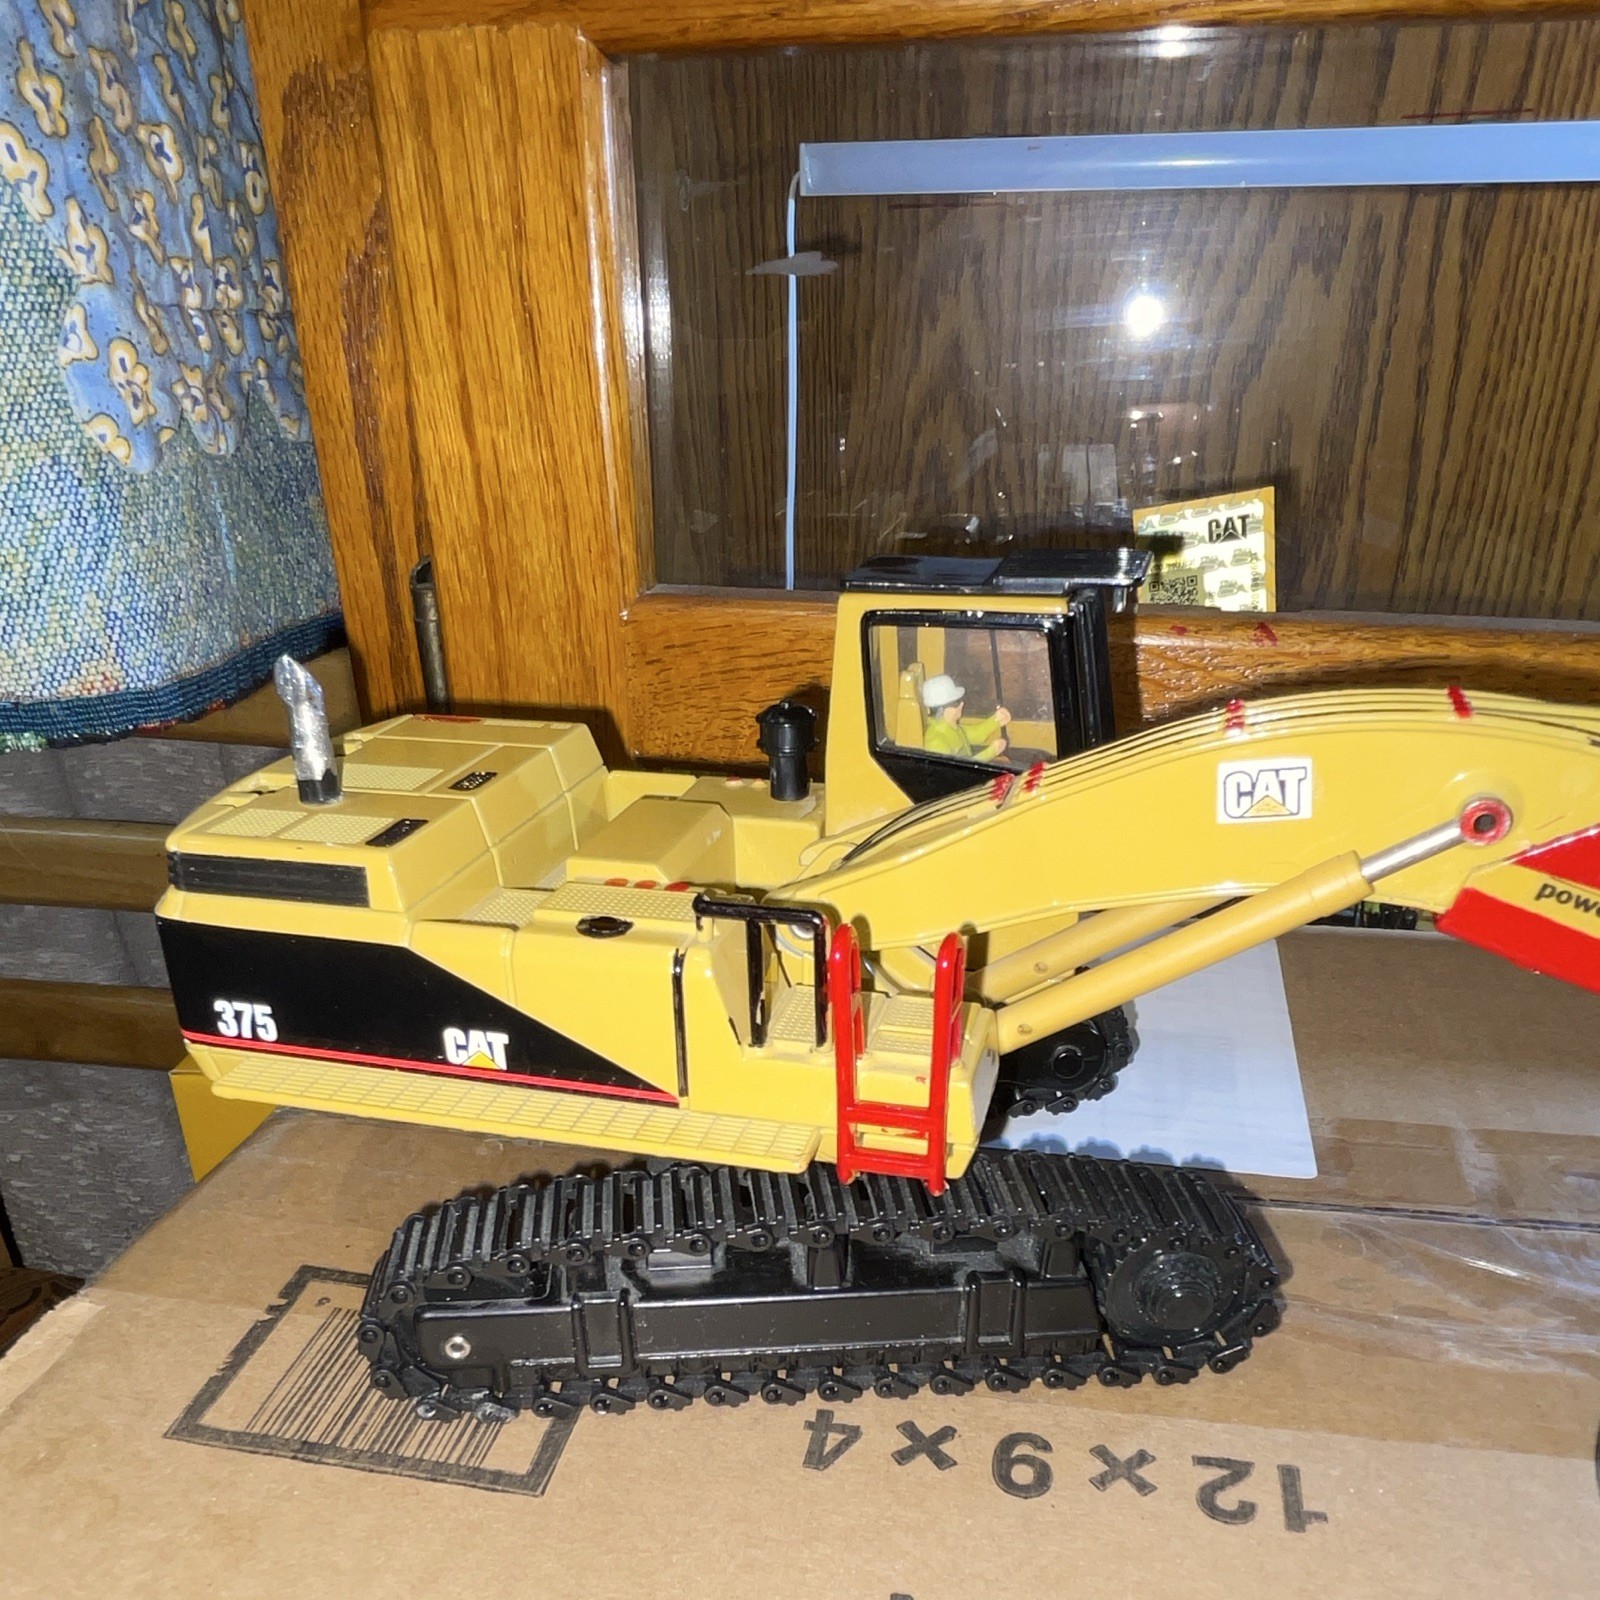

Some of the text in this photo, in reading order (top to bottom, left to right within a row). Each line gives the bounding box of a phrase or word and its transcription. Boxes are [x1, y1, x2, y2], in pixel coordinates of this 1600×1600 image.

[1207, 514, 1251, 544] CAT
[1223, 766, 1307, 818] CAT
[213, 1000, 278, 1042] 375
[442, 1028, 509, 1070] CAT
[802, 1408, 862, 1471] 4
[992, 1432, 1053, 1499] 9
[1191, 1454, 1328, 1533] 12
